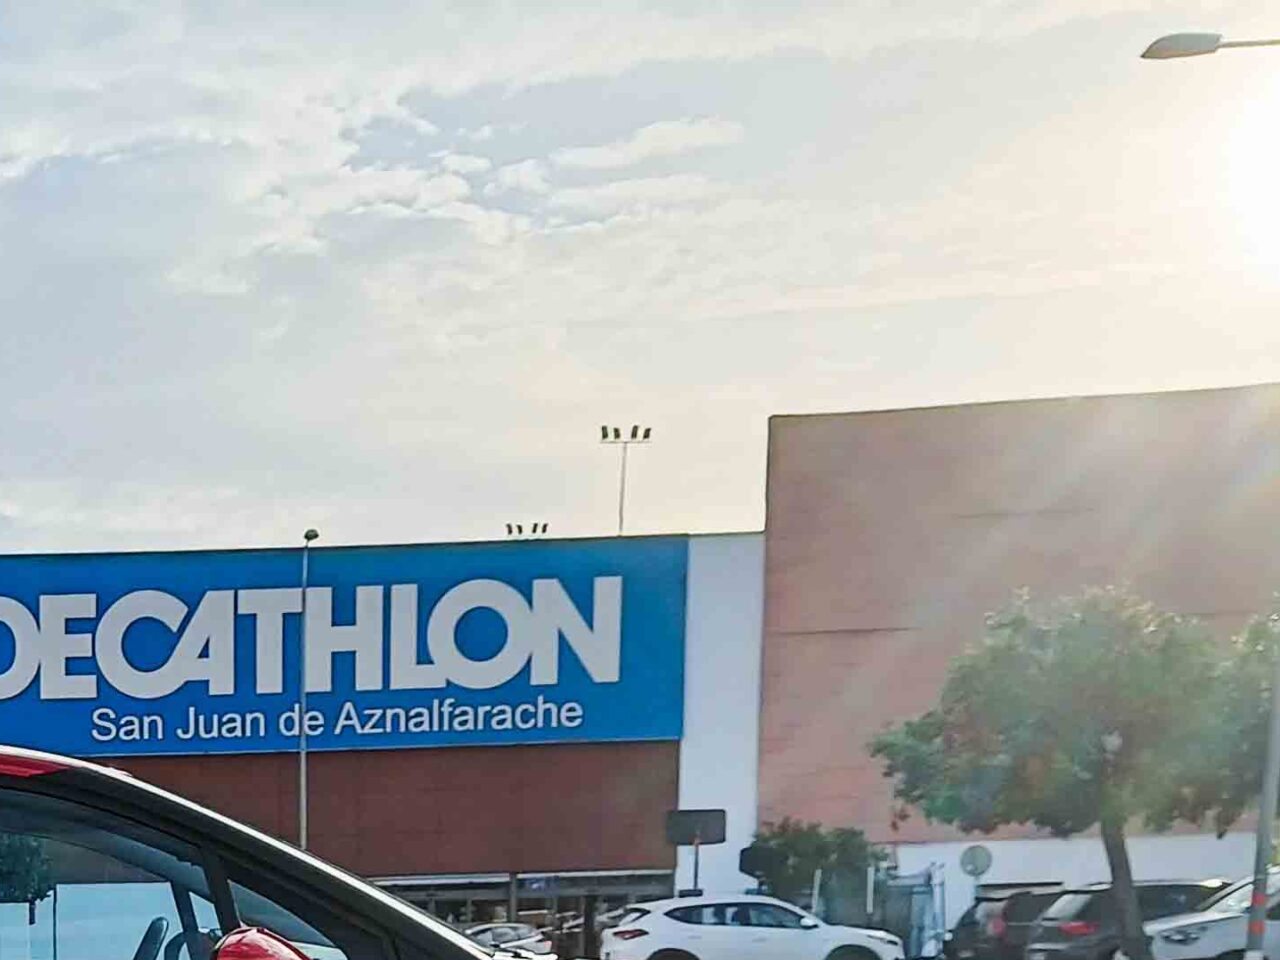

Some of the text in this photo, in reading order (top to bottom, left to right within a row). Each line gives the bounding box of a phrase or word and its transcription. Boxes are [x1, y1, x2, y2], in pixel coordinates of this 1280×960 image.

[91, 695, 583, 741] San Juan de Aznalfarache
